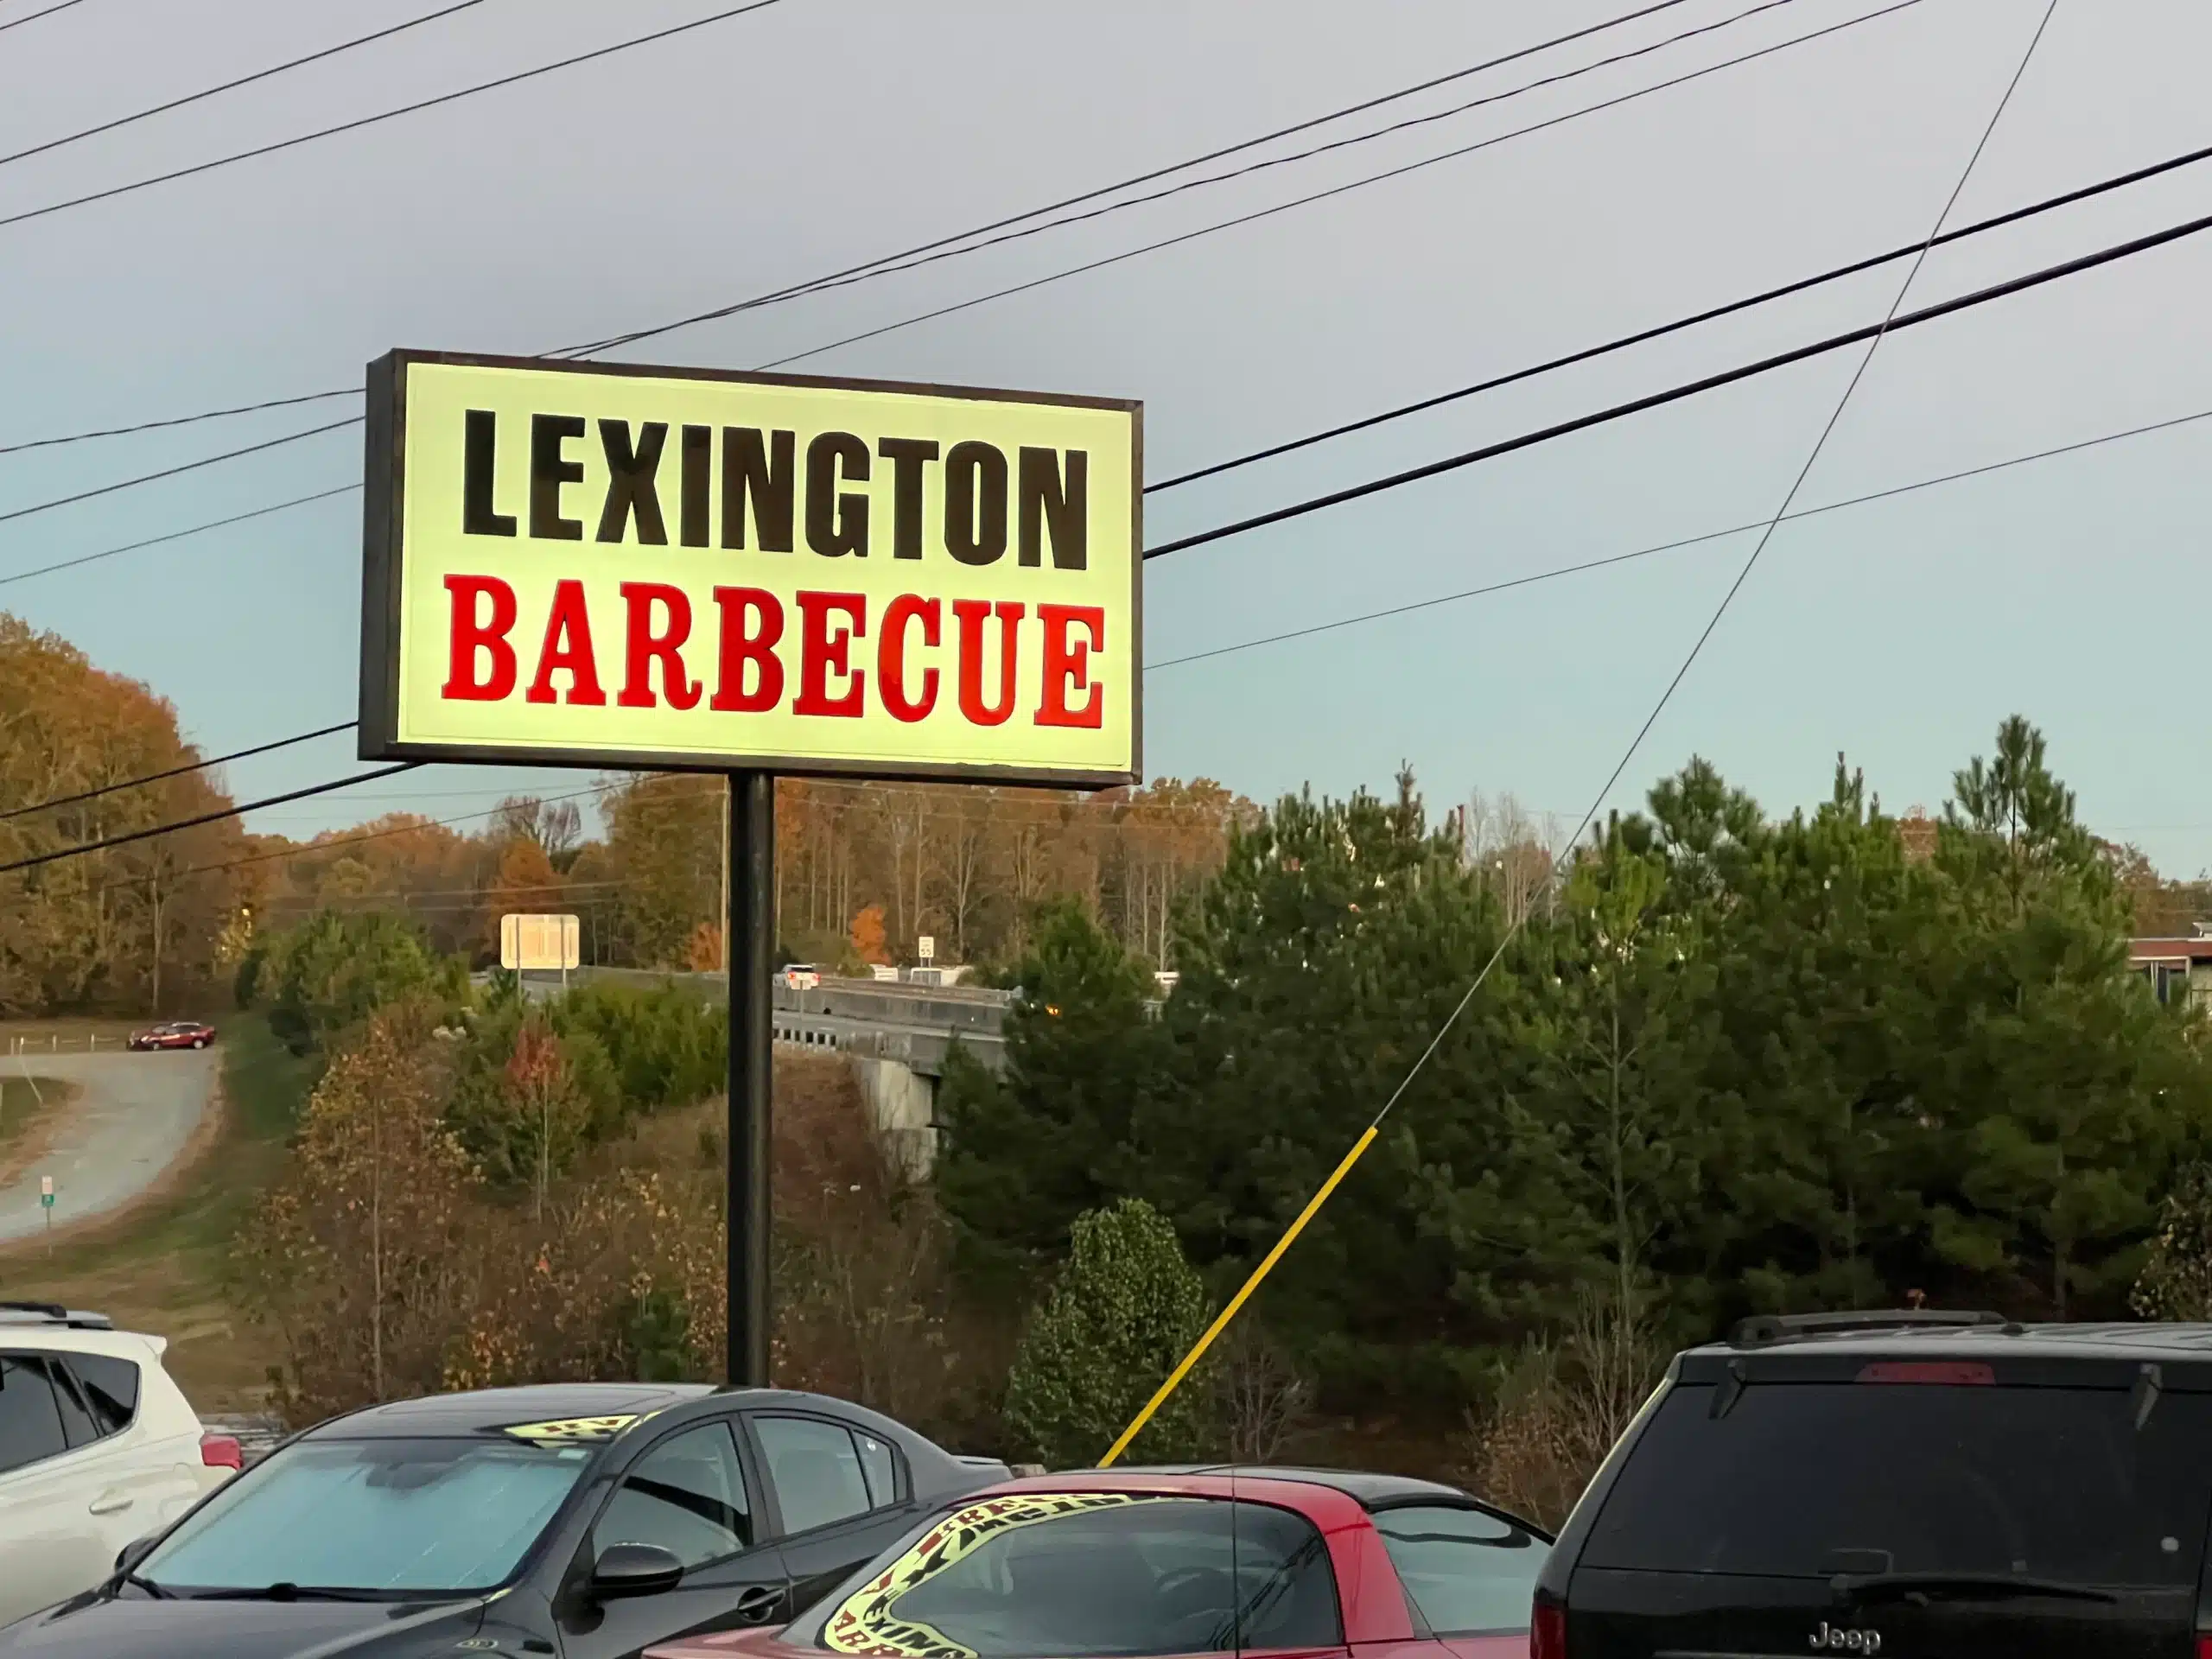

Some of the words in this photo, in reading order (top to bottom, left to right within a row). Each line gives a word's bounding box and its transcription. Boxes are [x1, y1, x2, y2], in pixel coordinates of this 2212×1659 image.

[463, 409, 1088, 571] LEXINGTON
[441, 574, 1105, 729] BARBECUE
[1808, 1621, 1881, 1655] Jeep
